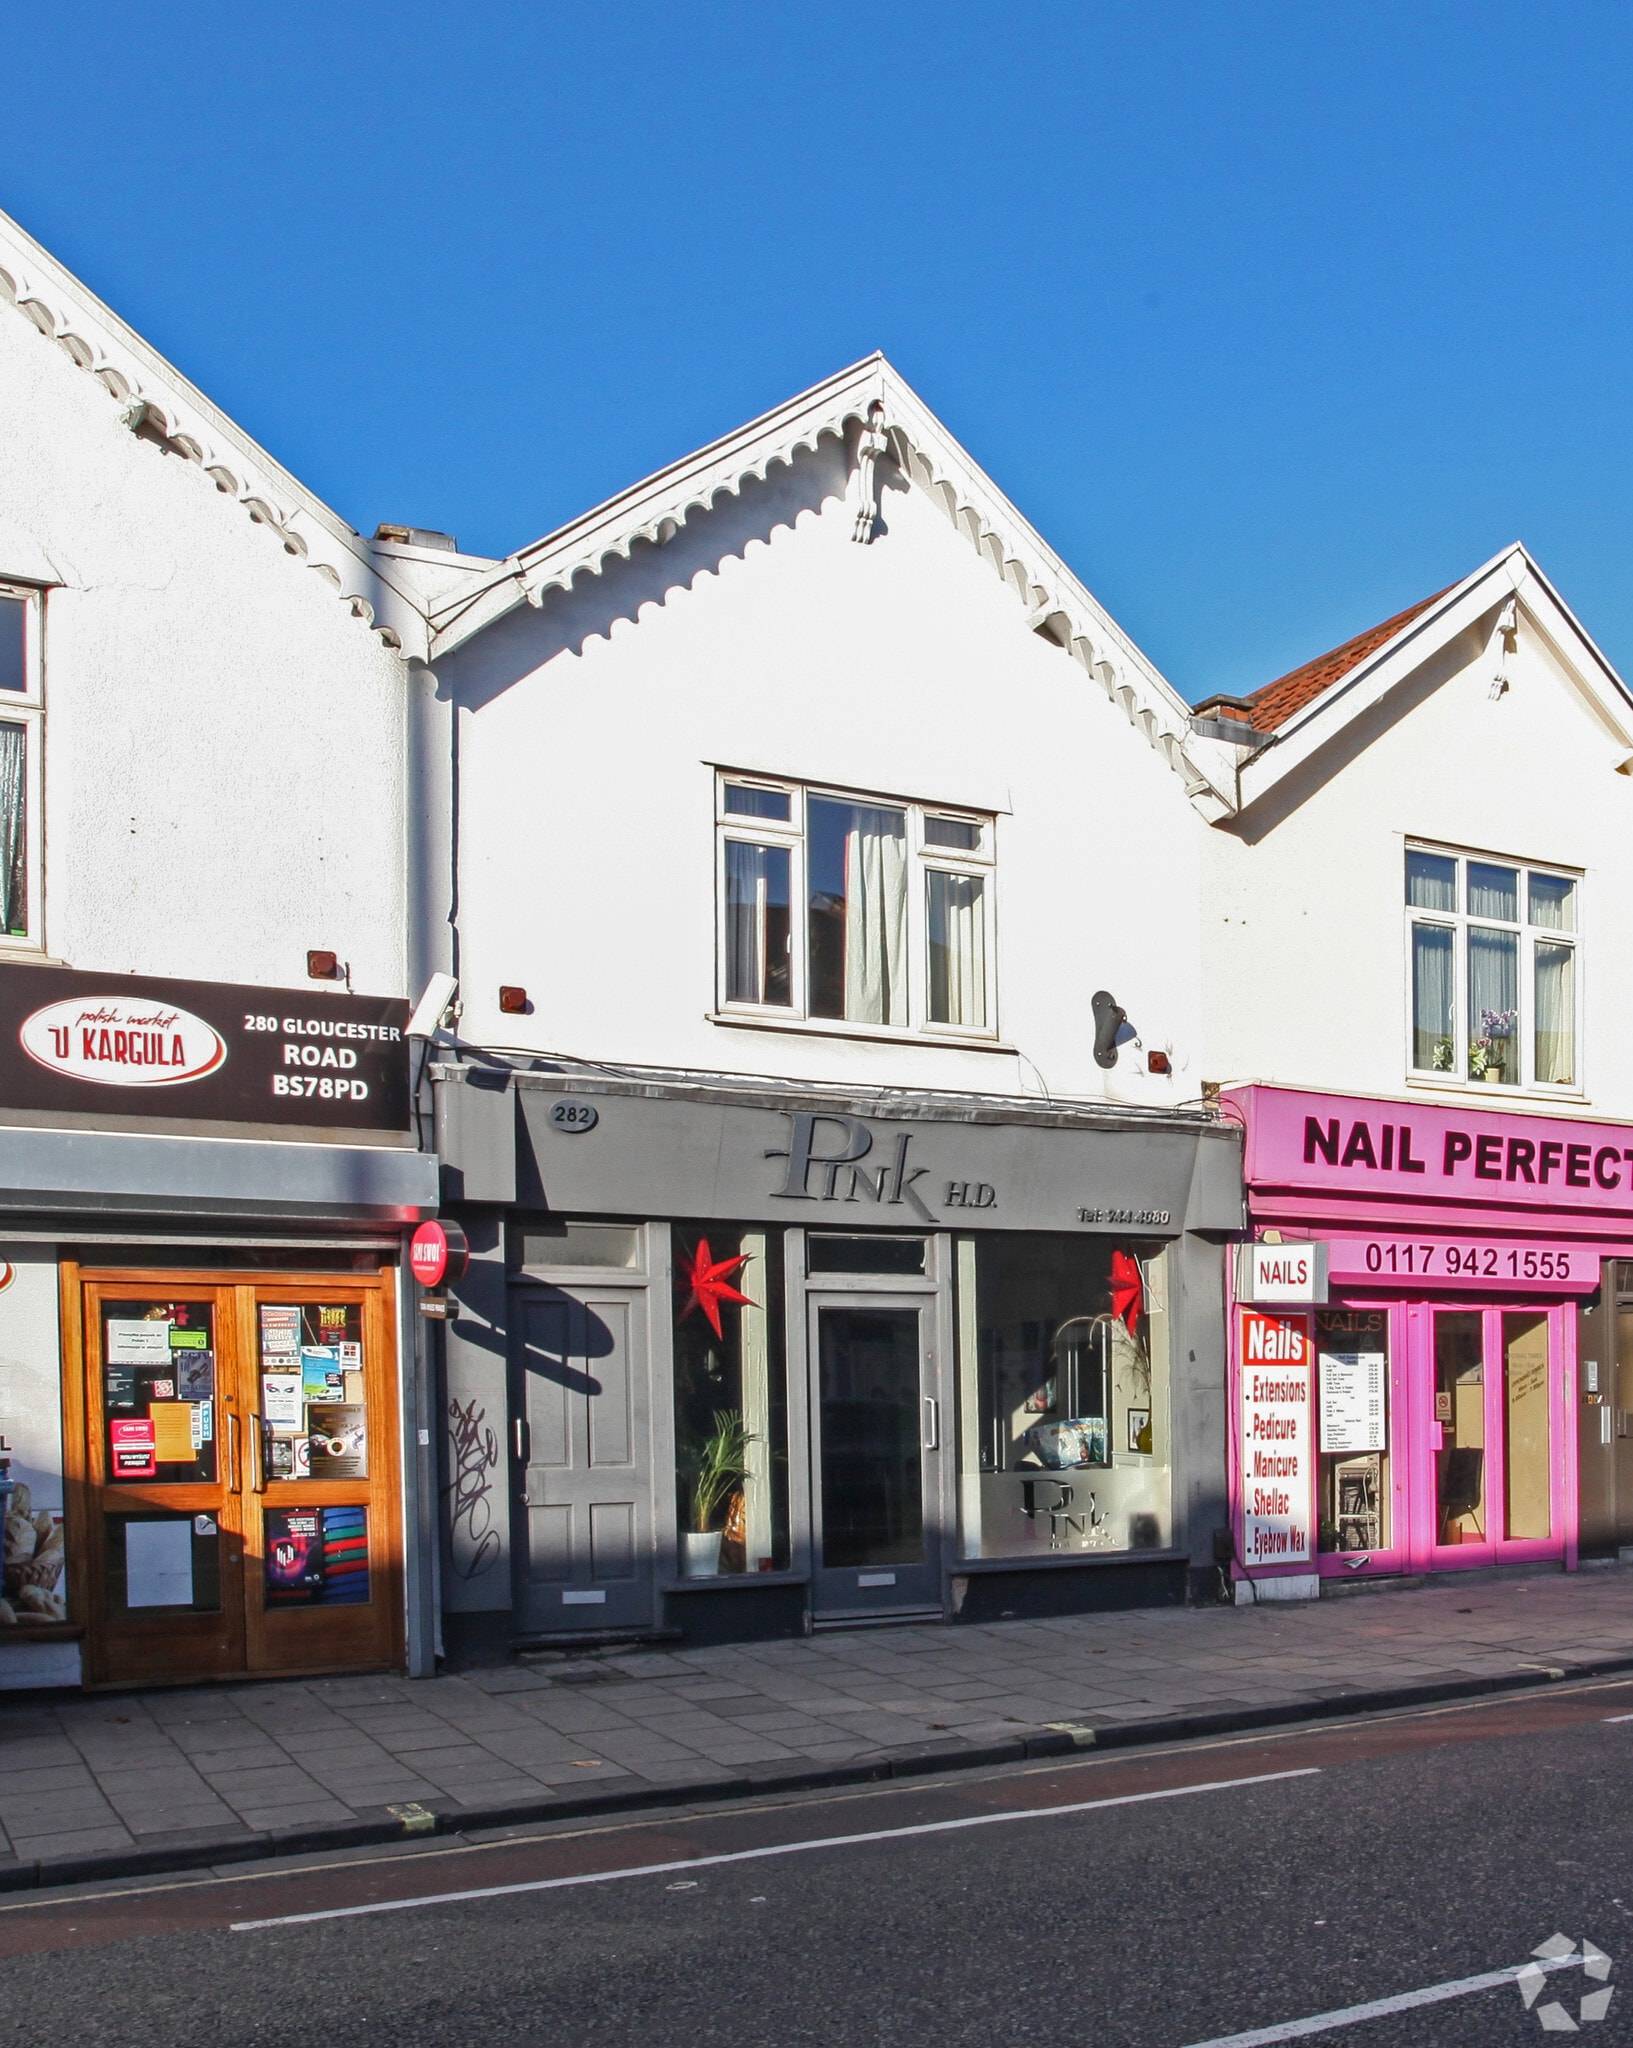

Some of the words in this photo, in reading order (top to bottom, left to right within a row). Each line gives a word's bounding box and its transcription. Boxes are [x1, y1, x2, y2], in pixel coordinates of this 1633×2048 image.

[75, 1007, 123, 1027] polish
[127, 1011, 180, 1029] market
[244, 1015, 278, 1032] 280
[283, 1018, 401, 1042] GLOUCESTER
[83, 1028, 186, 1067] KARGULA
[284, 1044, 357, 1069] ROAD
[273, 1074, 369, 1100] BS78PD
[555, 1106, 589, 1123] 282
[1303, 1115, 1426, 1174] NAIL
[944, 1181, 998, 1209] H.D.
[1260, 1259, 1307, 1285] NAILS
[1365, 1243, 1435, 1273] 0117
[1445, 1246, 1498, 1276] 942
[1507, 1249, 1571, 1280] 1555
[1313, 1312, 1383, 1332] NAILS
[1248, 1319, 1303, 1361] Nails
[1253, 1374, 1306, 1403] Extensions
[1253, 1412, 1297, 1440] Pedicure
[1253, 1449, 1298, 1478] Manicure
[1253, 1488, 1290, 1516] Shellac
[1254, 1526, 1288, 1562] Eyebrow
[1289, 1525, 1306, 1553] Wax
